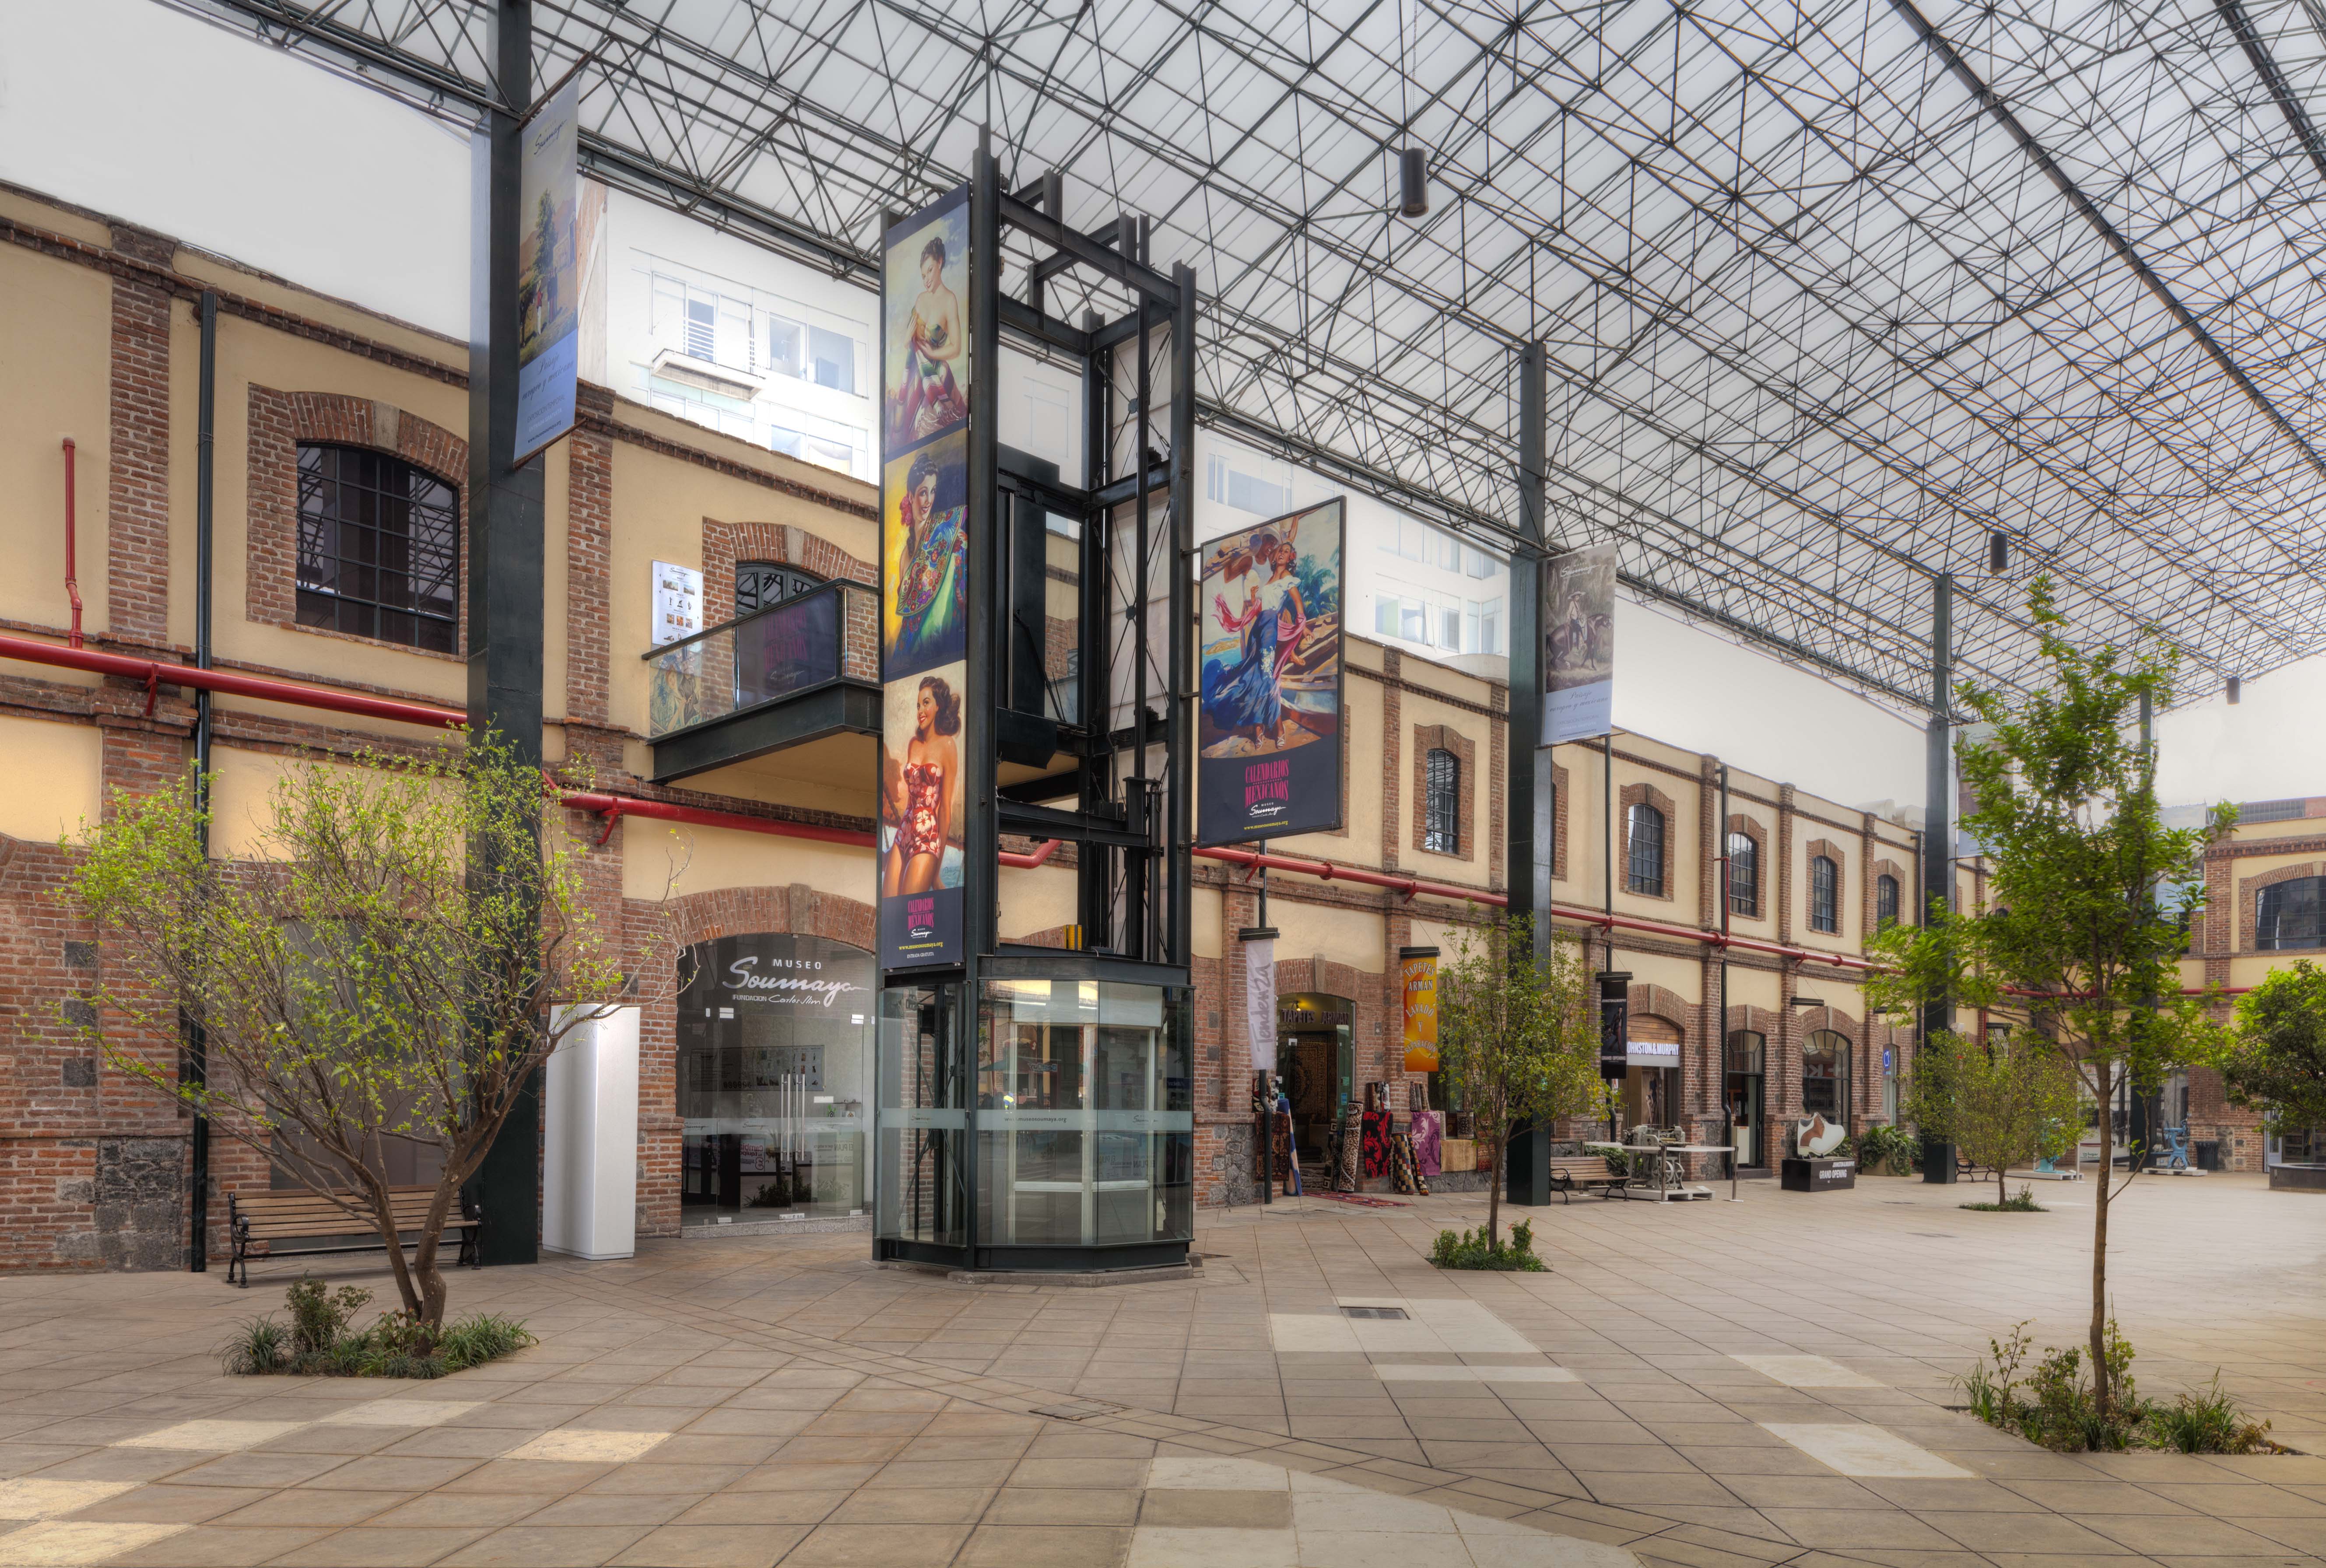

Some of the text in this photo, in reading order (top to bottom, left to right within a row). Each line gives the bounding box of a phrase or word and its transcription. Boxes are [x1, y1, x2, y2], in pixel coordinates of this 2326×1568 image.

[533, 119, 567, 155] Soumaya
[539, 352, 560, 375] Paisaje
[1245, 758, 1289, 784] CALENDARIOS
[1245, 779, 1289, 809] MEXICANOS
[1249, 804, 1286, 816] Soumaya
[898, 941, 944, 951] www.museosoumaya.org
[772, 958, 821, 970] MUSEO
[1403, 961, 1436, 977] TAPETES
[722, 956, 870, 1007] Soumaya
[1408, 979, 1433, 991] ARMAN
[768, 994, 800, 1004] Carlos
[800, 995, 821, 1005] Slim
[1282, 1008, 1349, 1025] TAPETES ARMAN
[1406, 1003, 1435, 1018] LAVADO
[1417, 1021, 1423, 1032] Y
[1627, 1041, 1679, 1056] OHNSTON&MURPHY
[1819, 1169, 1847, 1179] GRAND OPENING
